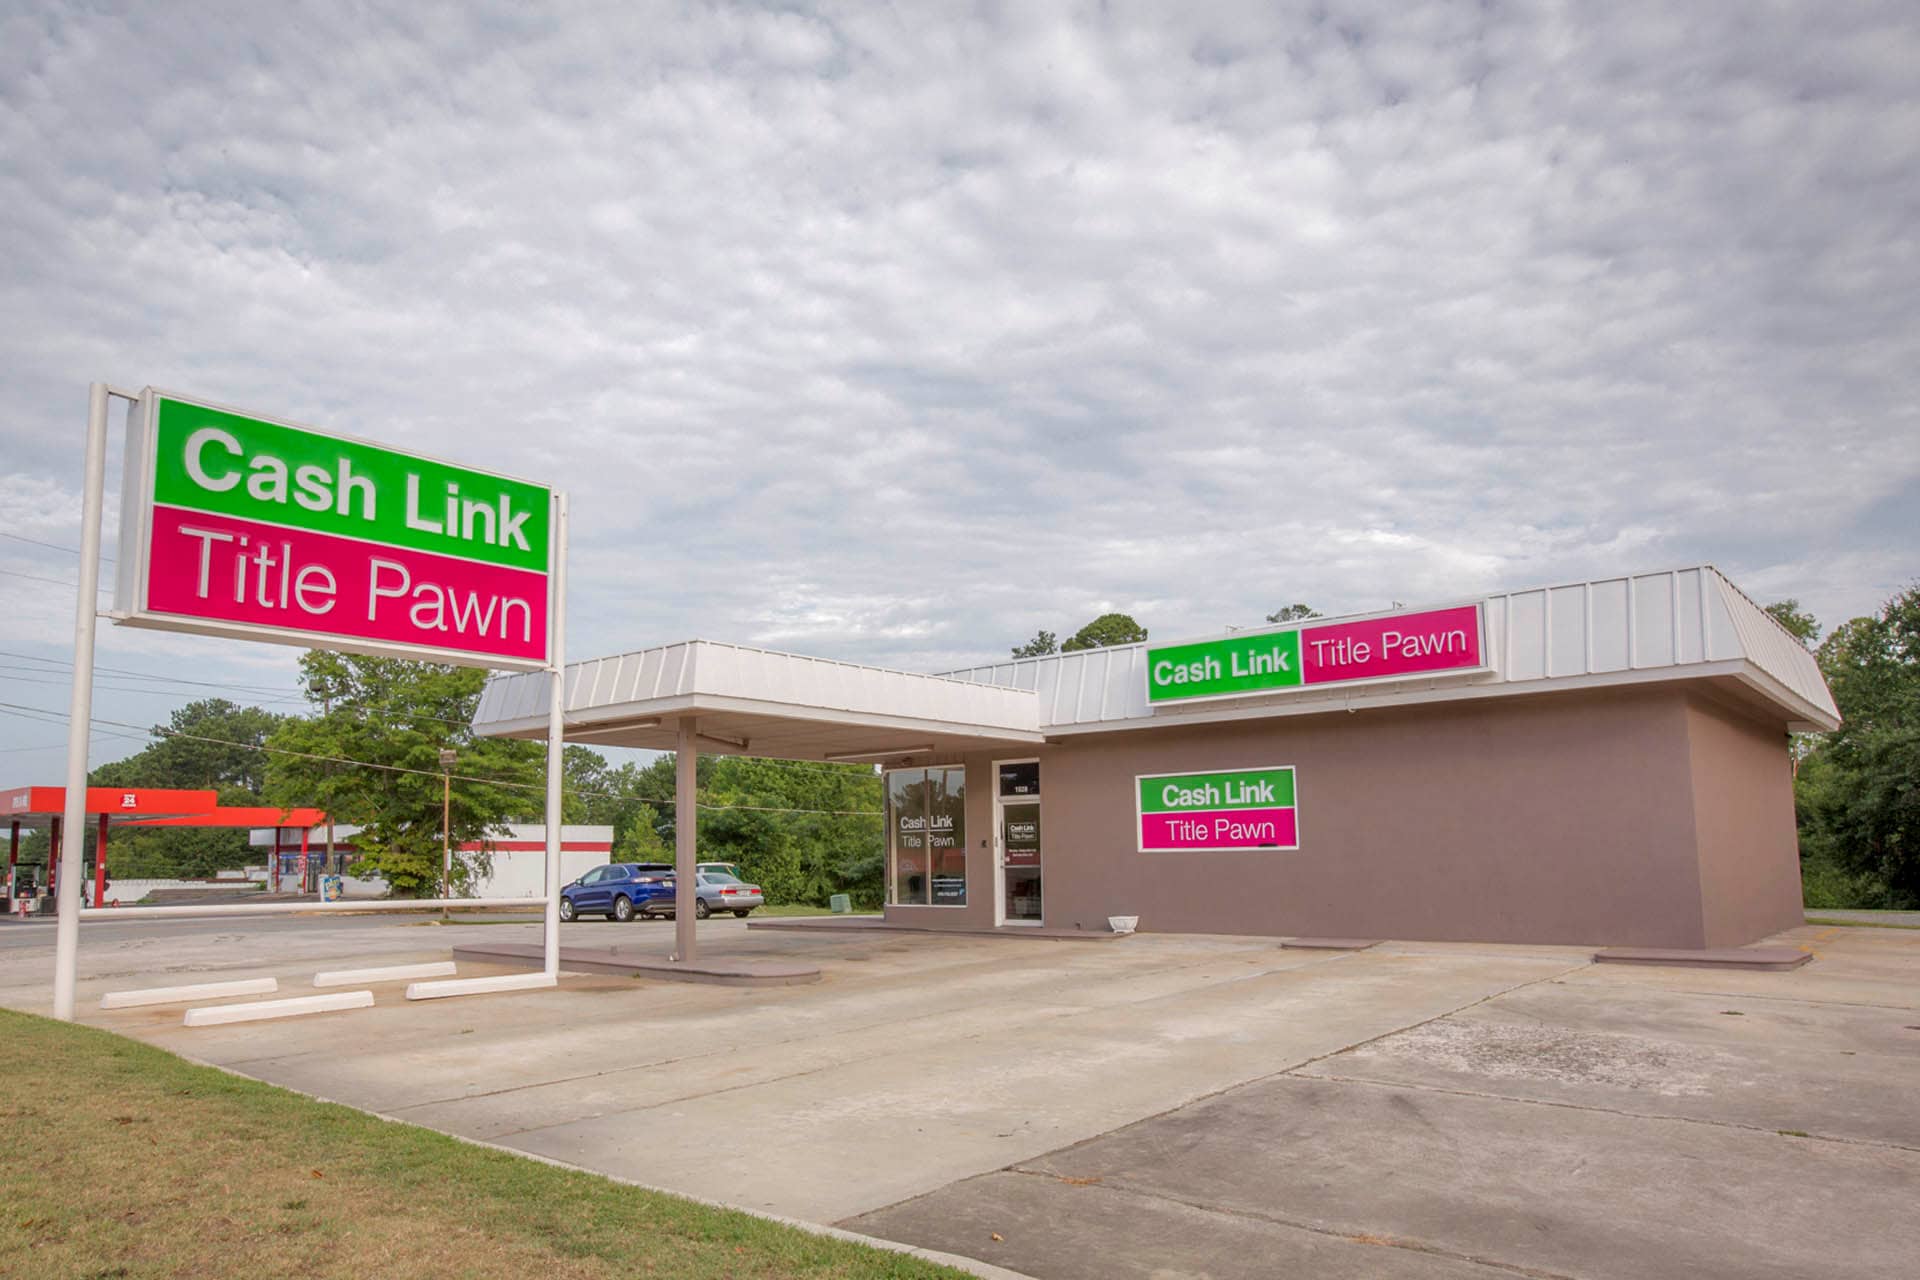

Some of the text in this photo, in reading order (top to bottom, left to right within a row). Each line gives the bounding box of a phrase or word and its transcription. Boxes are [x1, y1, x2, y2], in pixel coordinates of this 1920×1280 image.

[183, 428, 531, 552] Cash Link
[178, 526, 532, 643] Title Pawn
[1154, 629, 1467, 686] Cash Link Title Pawn
[1162, 780, 1276, 807] Cash Link
[900, 814, 953, 829] Cash Link
[1165, 818, 1275, 841] Title Pawn
[902, 834, 955, 848] Title Pawn
